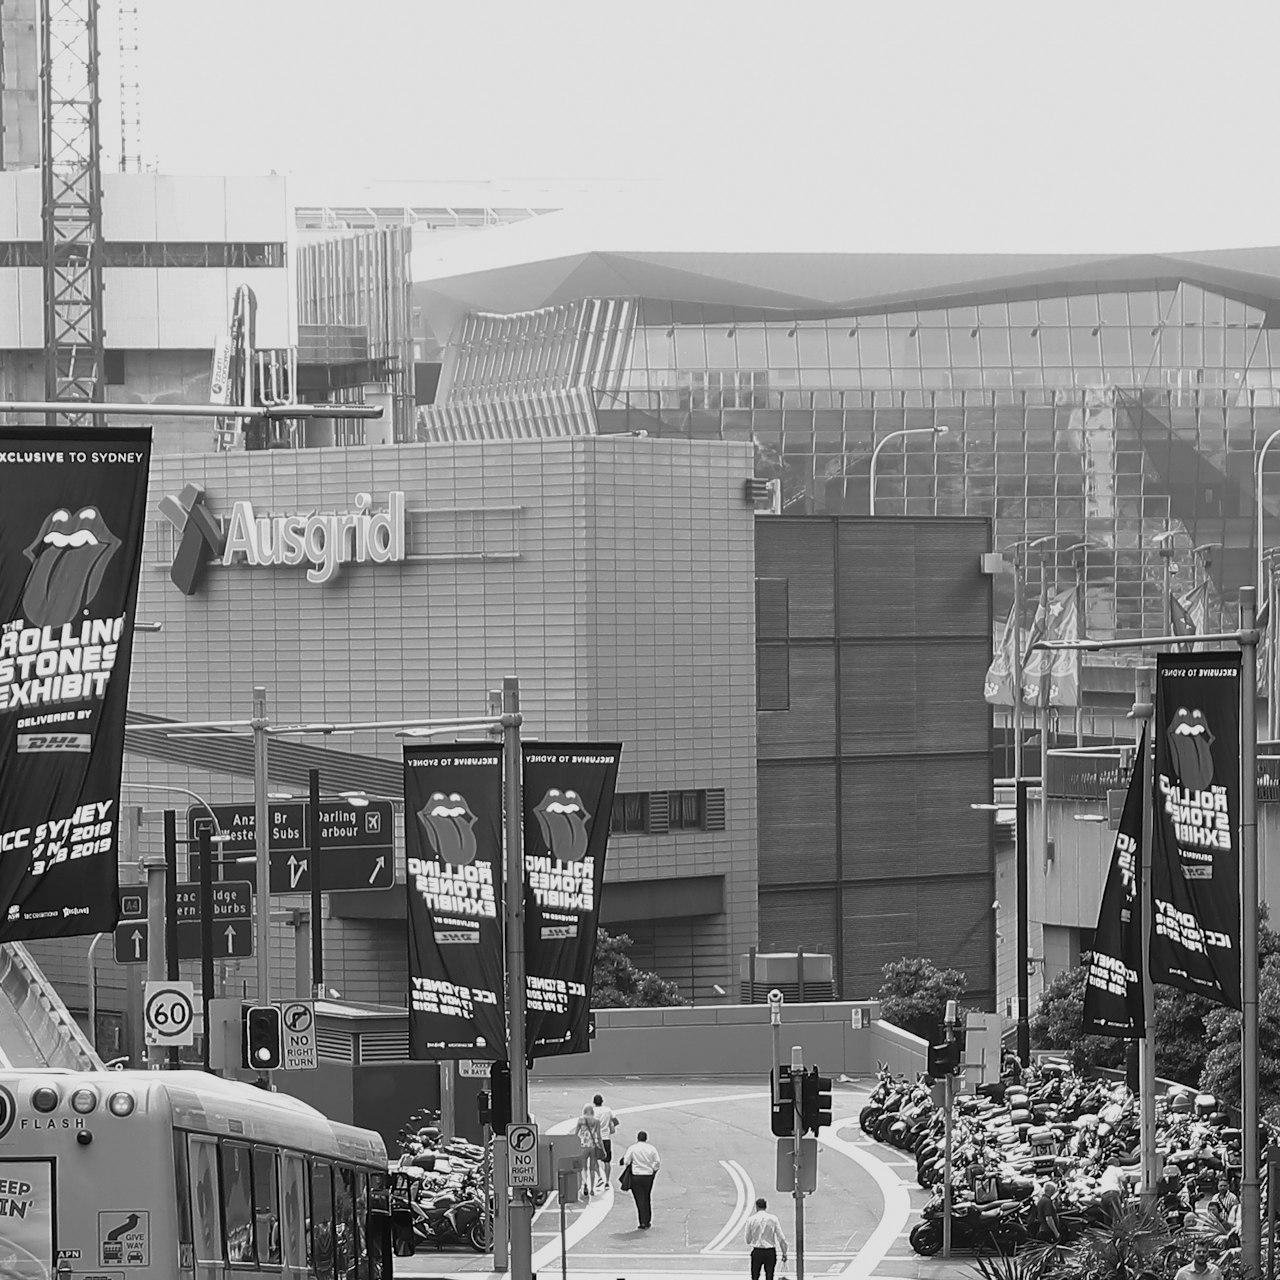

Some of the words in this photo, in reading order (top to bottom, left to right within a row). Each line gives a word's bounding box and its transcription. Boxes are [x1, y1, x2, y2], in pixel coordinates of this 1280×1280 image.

[69, 453, 87, 463] TO
[91, 452, 143, 463] SYDNEY
[222, 491, 406, 582] Ausgrid
[2, 619, 24, 633] THE
[17, 713, 72, 728] DELIVERED
[75, 710, 92, 722] BY
[27, 735, 81, 749] DHL
[274, 812, 287, 824] Br
[70, 821, 112, 842] 2018
[273, 827, 300, 840] Subs
[322, 826, 358, 838] arbour
[70, 838, 111, 859] 2019
[176, 893, 196, 901] zac
[214, 904, 246, 914] burbs
[154, 1002, 186, 1025] 60
[290, 1036, 309, 1046] NO
[287, 1048, 314, 1057] RIGHT
[288, 1058, 314, 1066] TURN
[21, 1118, 84, 1129] FLASH
[515, 1155, 531, 1164] NO
[513, 1175, 534, 1183] TURN
[125, 1233, 144, 1241] GIVE
